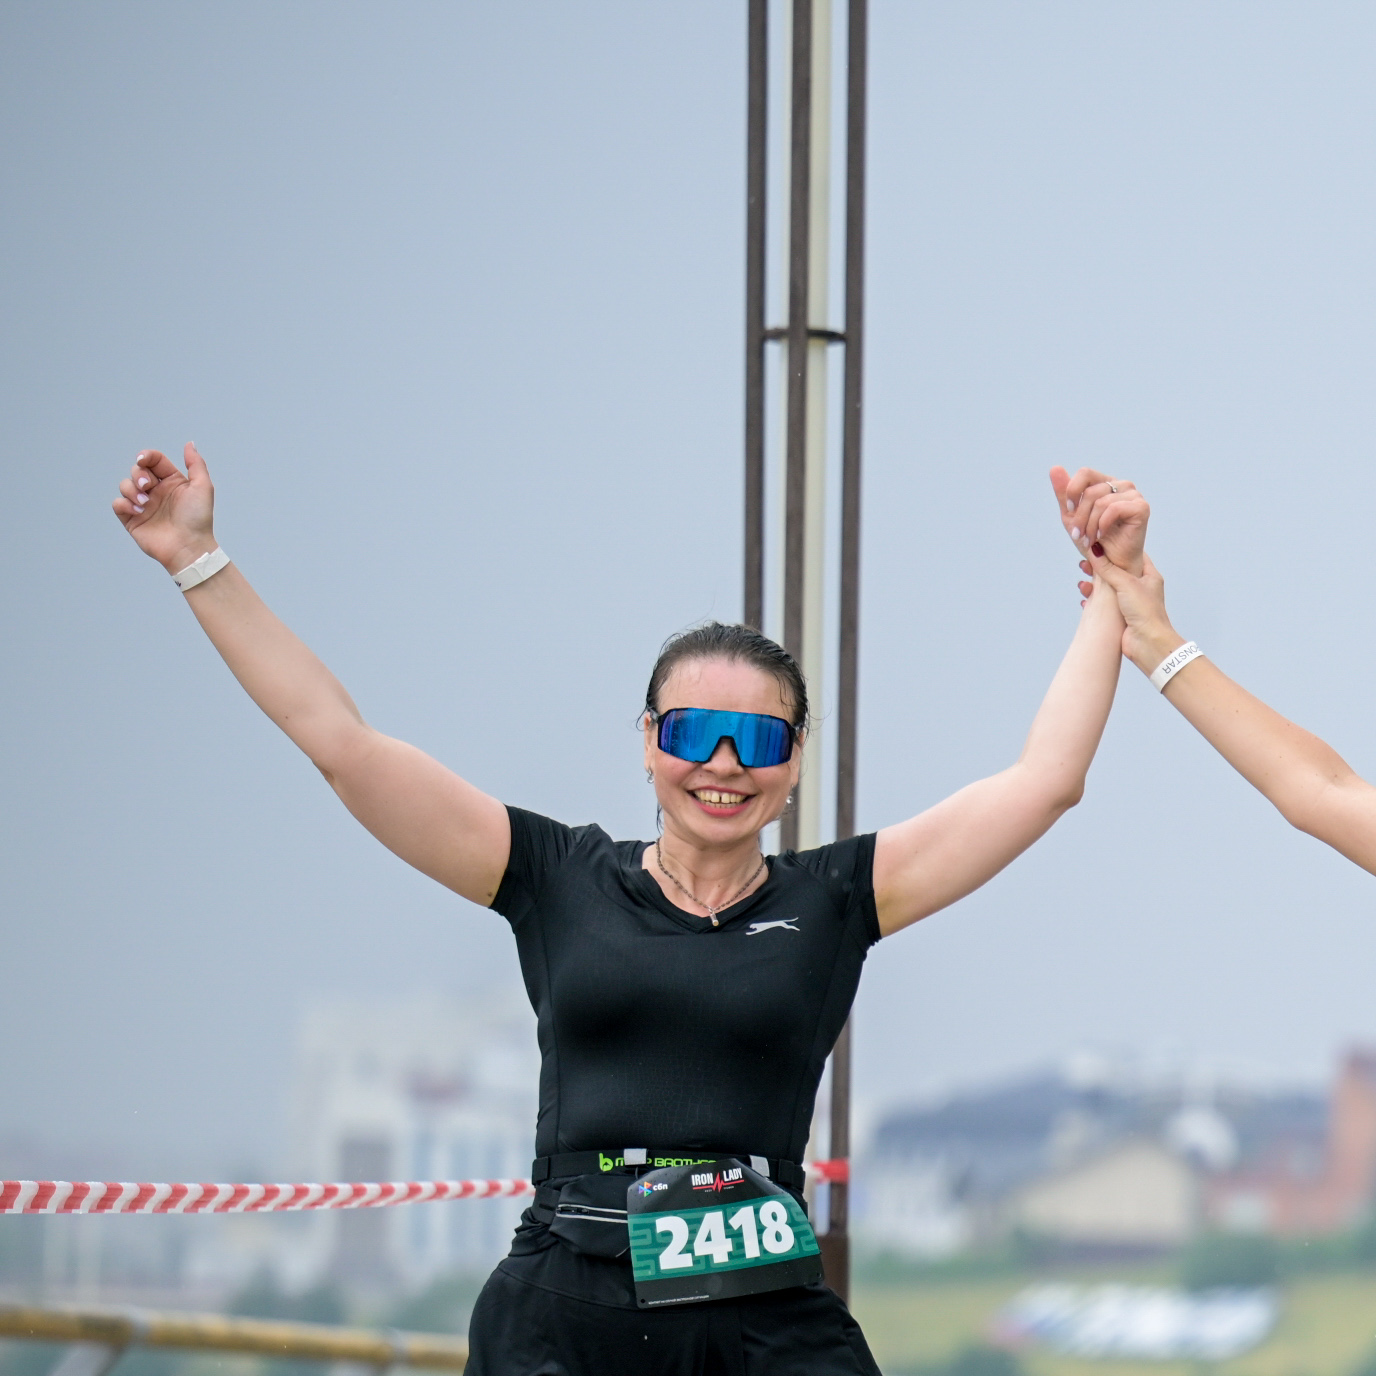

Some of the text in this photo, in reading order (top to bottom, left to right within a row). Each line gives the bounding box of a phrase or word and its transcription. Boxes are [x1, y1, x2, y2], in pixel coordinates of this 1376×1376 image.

[691, 1167, 743, 1186] IRON LADY
[655, 1200, 795, 1271] 2418
